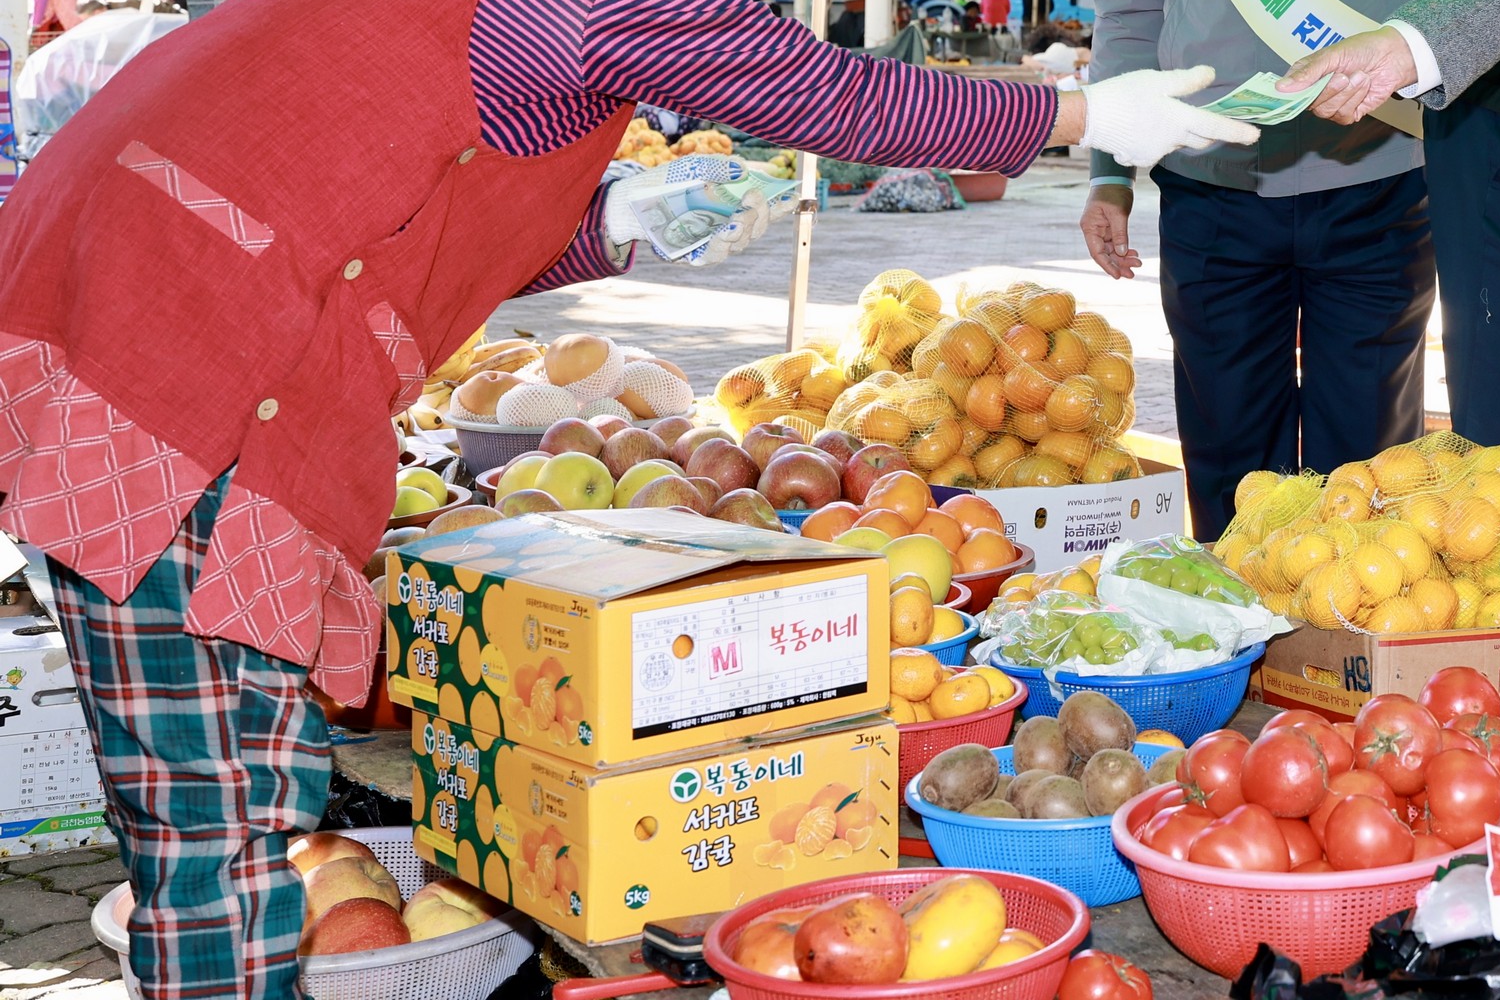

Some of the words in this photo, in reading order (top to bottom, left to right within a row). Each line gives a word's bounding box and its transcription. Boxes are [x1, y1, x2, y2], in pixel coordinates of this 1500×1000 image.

[1104, 495, 1122, 503] Product
[1155, 491, 1172, 514] A6
[1064, 520, 1122, 539] (주)진원무역
[1065, 510, 1122, 523] www.jinwon.kr
[414, 577, 464, 617] 복동이네
[412, 614, 450, 645] 서귀포
[768, 612, 858, 656] 복동이네
[412, 647, 440, 678] 감귤
[710, 641, 738, 673] M
[577, 725, 593, 744] 5kg
[855, 733, 882, 747] Jeju
[437, 730, 480, 774] 복동이네
[437, 768, 468, 800] 서귀포
[704, 752, 804, 796] 복동이네
[436, 800, 458, 832] 감귤
[682, 796, 760, 834] 서귀포
[681, 835, 736, 873] 감귤
[624, 888, 651, 907] 5kg
